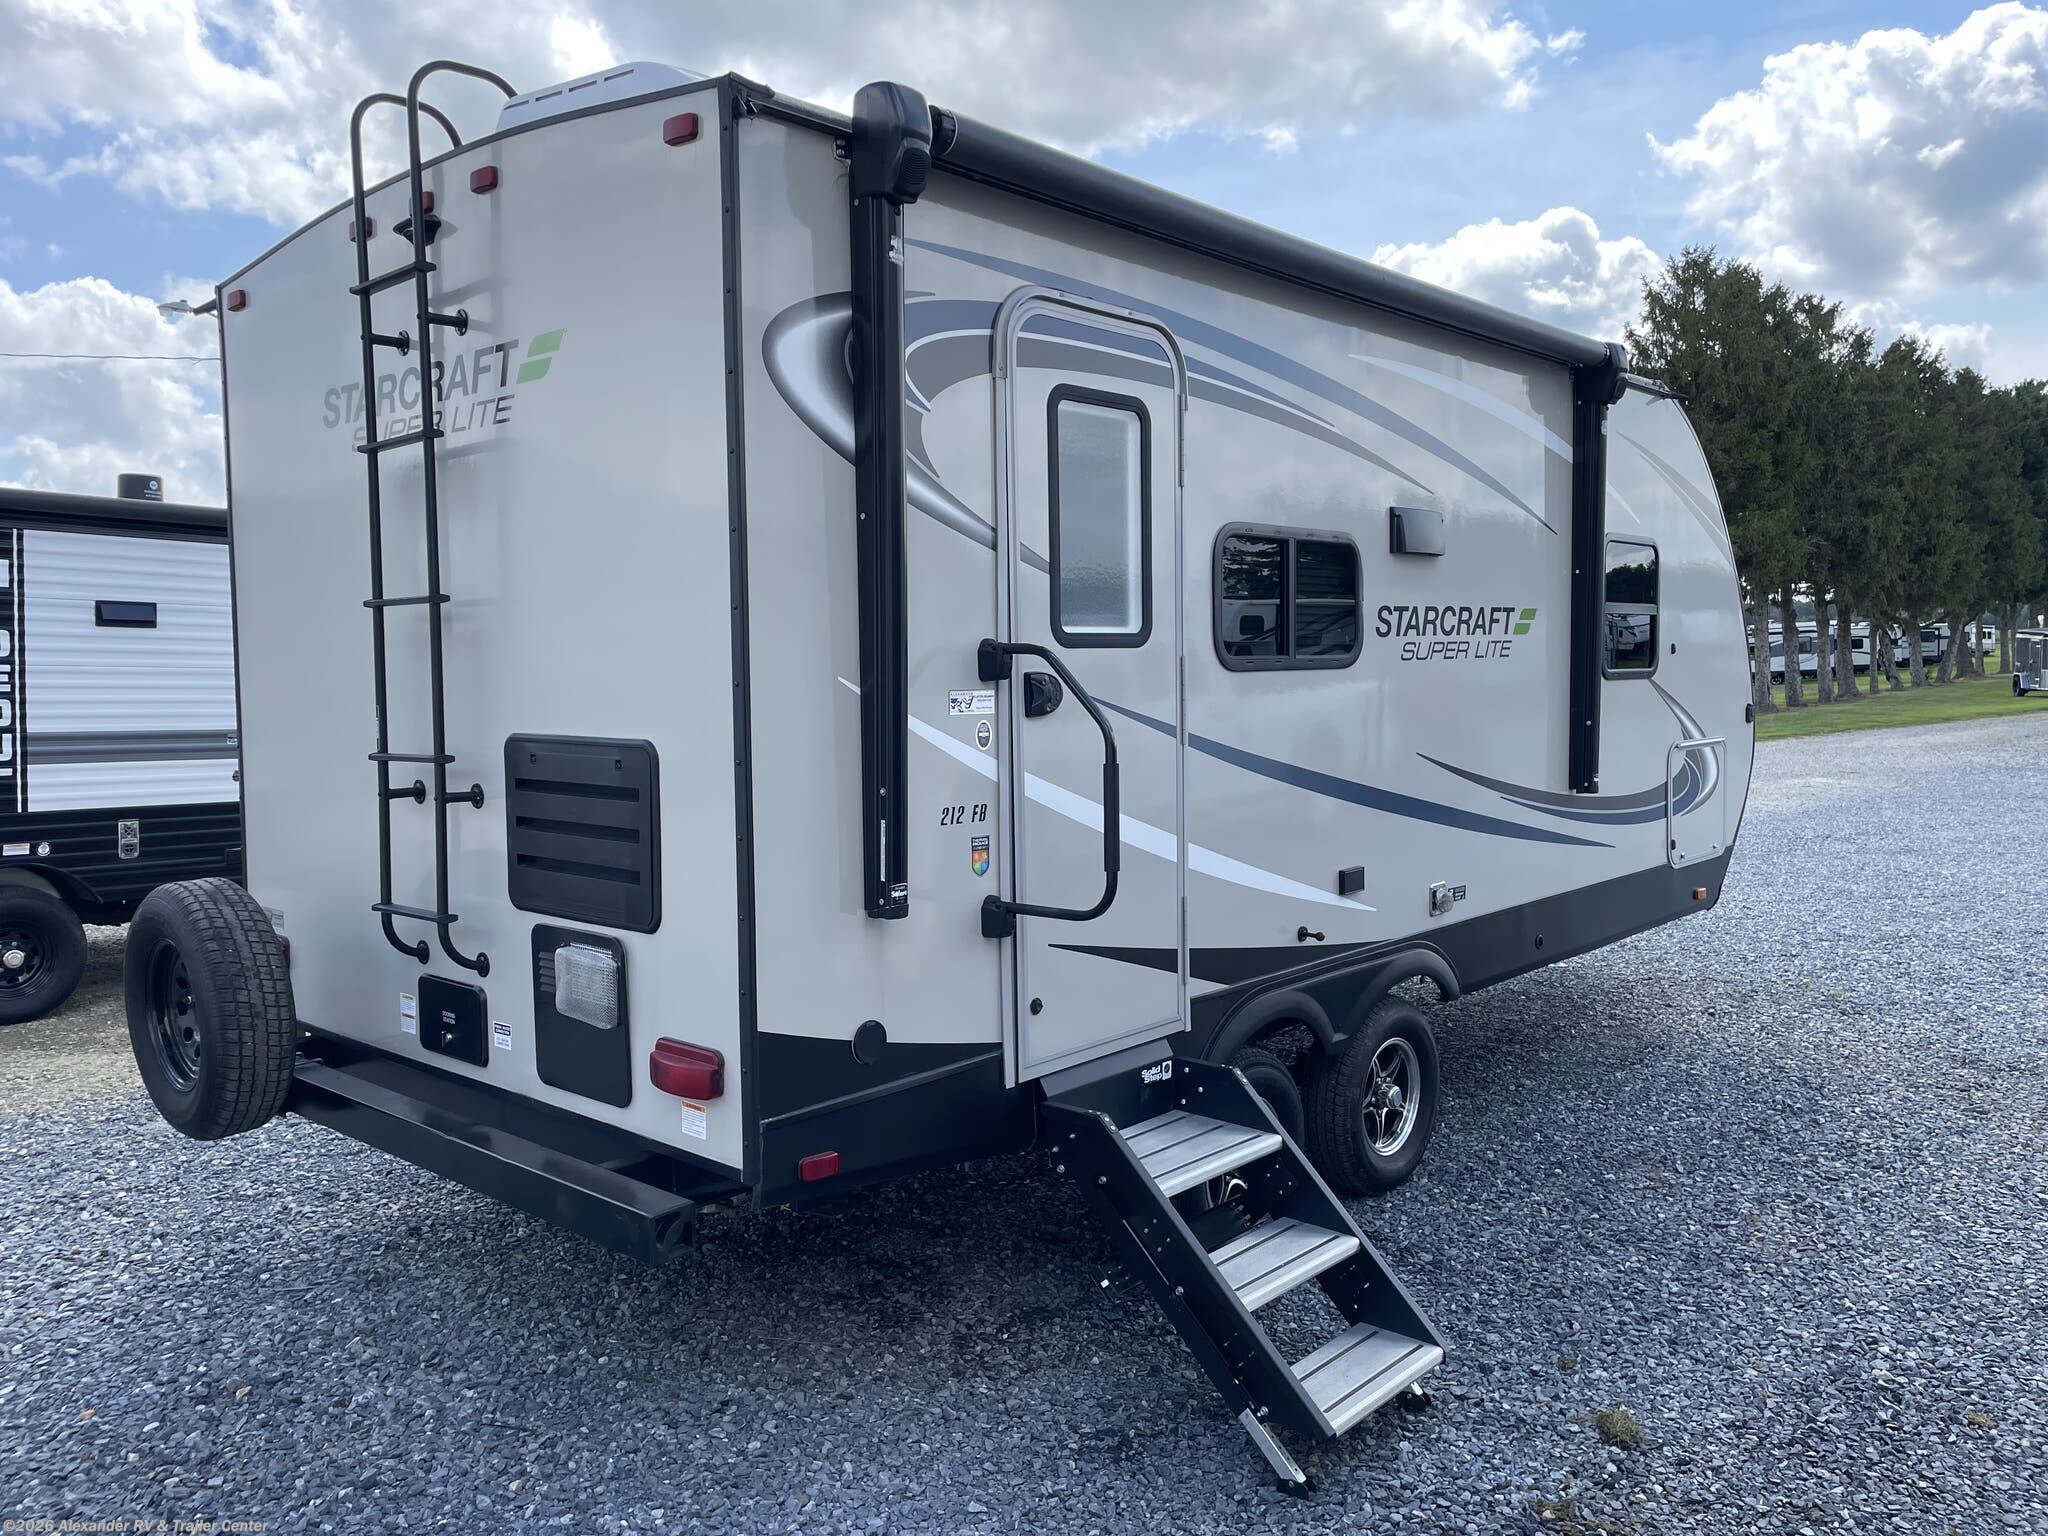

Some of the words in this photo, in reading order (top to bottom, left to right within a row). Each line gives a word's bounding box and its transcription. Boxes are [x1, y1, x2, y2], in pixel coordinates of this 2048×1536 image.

[451, 394, 515, 433] LITE
[1375, 605, 1515, 638] STARCRAFT
[1401, 641, 1470, 661] SUPER
[1474, 640, 1512, 659] LITE
[940, 805, 965, 826] 212
[971, 803, 988, 823] FB
[1141, 1064, 1161, 1078] Solid
[1143, 1073, 1163, 1084] Step
